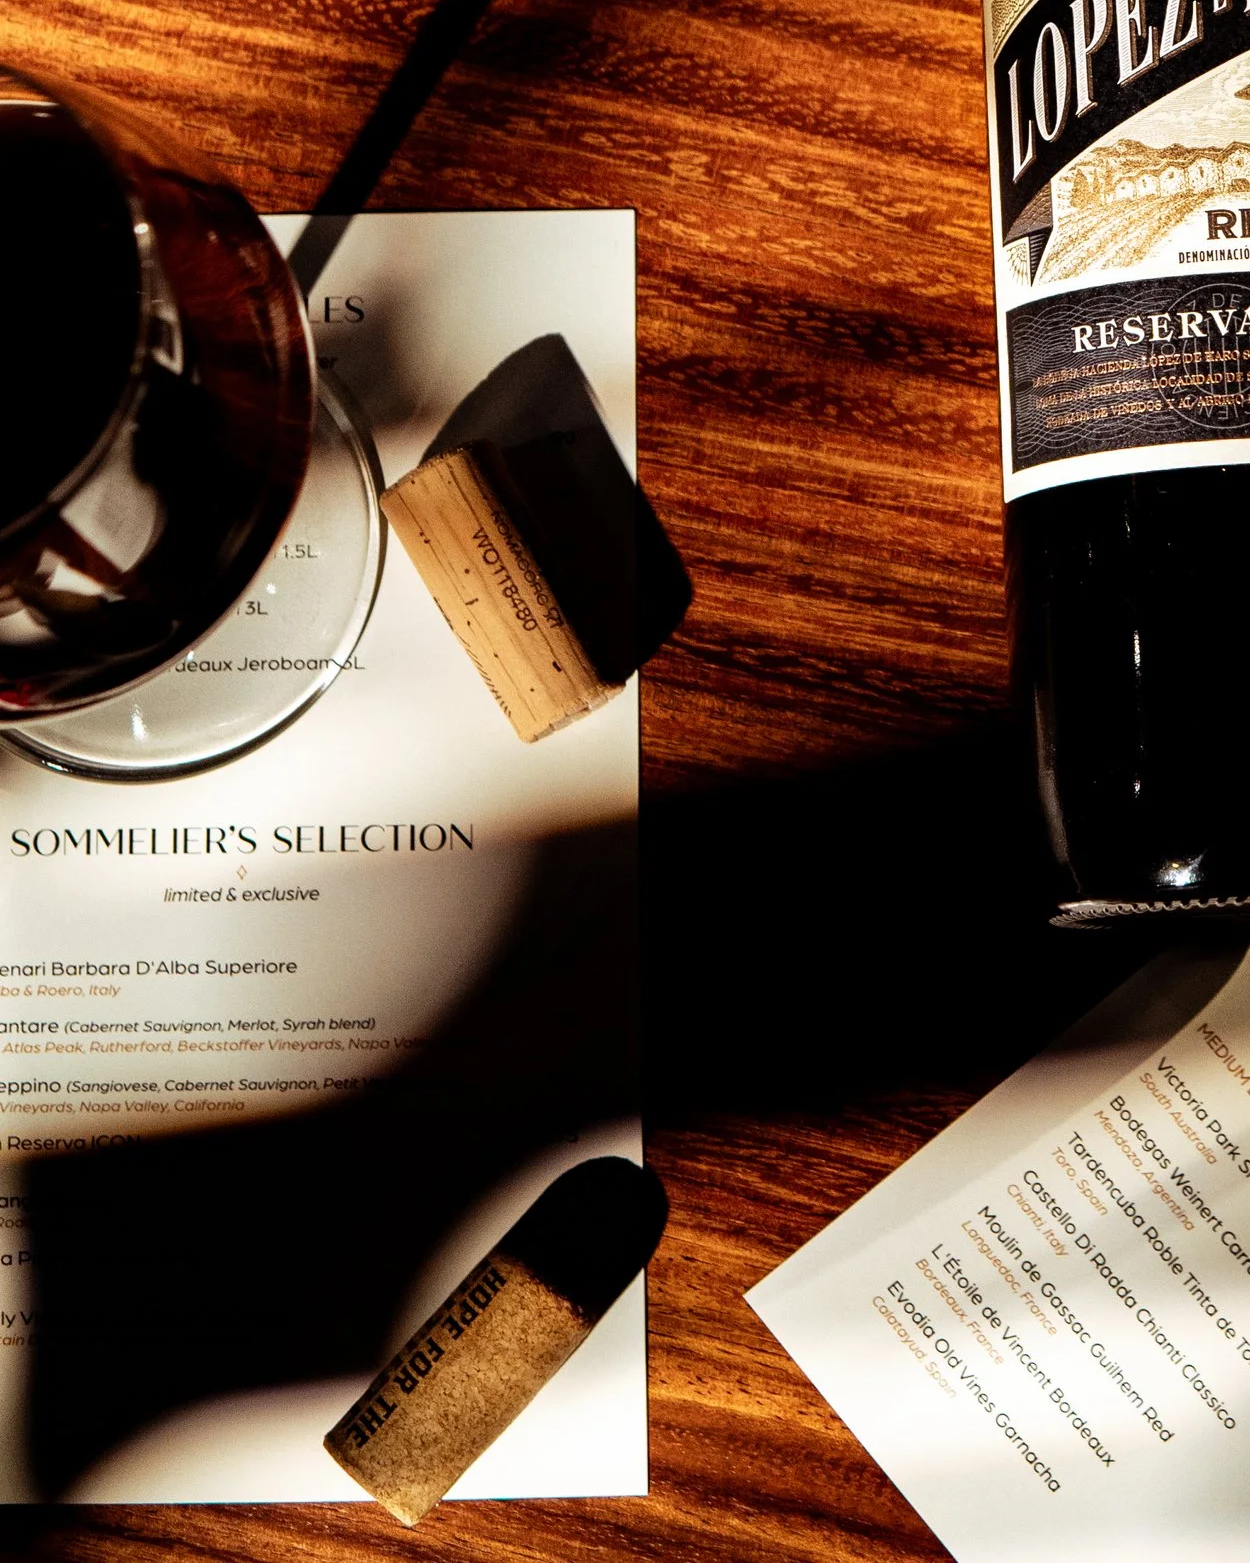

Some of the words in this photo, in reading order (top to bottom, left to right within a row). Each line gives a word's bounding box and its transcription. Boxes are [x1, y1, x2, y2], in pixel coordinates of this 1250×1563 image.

[7, 823, 258, 859] SOMMELIER'S
[270, 821, 478, 855] SELECTION
[163, 887, 223, 903] limited
[225, 886, 237, 903] &
[241, 885, 321, 902] exclusive
[0, 961, 46, 978] enari
[50, 961, 131, 977] Barbara
[135, 960, 200, 976] D'Alba
[204, 958, 298, 976] Superiore
[0, 1019, 60, 1034] antare
[63, 1020, 140, 1035] (Cabernet
[142, 1019, 224, 1035] Sauvignon,
[227, 1018, 279, 1033] Merlot,
[281, 1017, 326, 1033] Syrah
[327, 1016, 376, 1032] blend)
[0, 1077, 62, 1096] eppino
[65, 1079, 161, 1095] (Sangiovese,
[163, 1079, 235, 1092] Cabernet
[237, 1077, 321, 1093] Sauvignon,
[0, 1101, 76, 1114] Vineyards,
[78, 1100, 122, 1114] Napa
[123, 1099, 171, 1114] Valley,
[172, 1097, 246, 1114] California
[1156, 1055, 1209, 1122] Victoria
[1205, 1118, 1241, 1162] Park
[6, 1135, 88, 1151] Reserva
[90, 1131, 142, 1149] ICON
[1108, 1094, 1171, 1170] Bodegas
[1169, 1166, 1223, 1233] Weinert
[1067, 1130, 1146, 1229] Tardencuba
[1141, 1225, 1184, 1275] Roble
[1182, 1271, 1219, 1317] Tinta
[1215, 1317, 1236, 1340] de
[438, 1263, 509, 1342] HOPE
[976, 1205, 1023, 1261] Moulin
[1020, 1259, 1042, 1283] de
[1039, 1281, 1091, 1344] Gassac
[1089, 1342, 1144, 1409] Guilhem
[1141, 1405, 1175, 1443] Red
[1022, 1169, 1077, 1235] Castello
[1073, 1232, 1096, 1255] Di
[1088, 1251, 1138, 1309] Radda
[1135, 1307, 1186, 1365] Chianti
[1181, 1363, 1237, 1430] Classico
[389, 1335, 447, 1397] FOR
[886, 1279, 936, 1339] Evodia
[934, 1337, 963, 1369] Old
[959, 1365, 996, 1413] Vines
[994, 1412, 1061, 1493] Garnacha
[930, 1242, 983, 1306] L'Étoile
[980, 1305, 1002, 1329] de
[1001, 1325, 1052, 1390] Vincent
[1048, 1386, 1116, 1468] Bordeaux
[343, 1391, 399, 1450] THE
